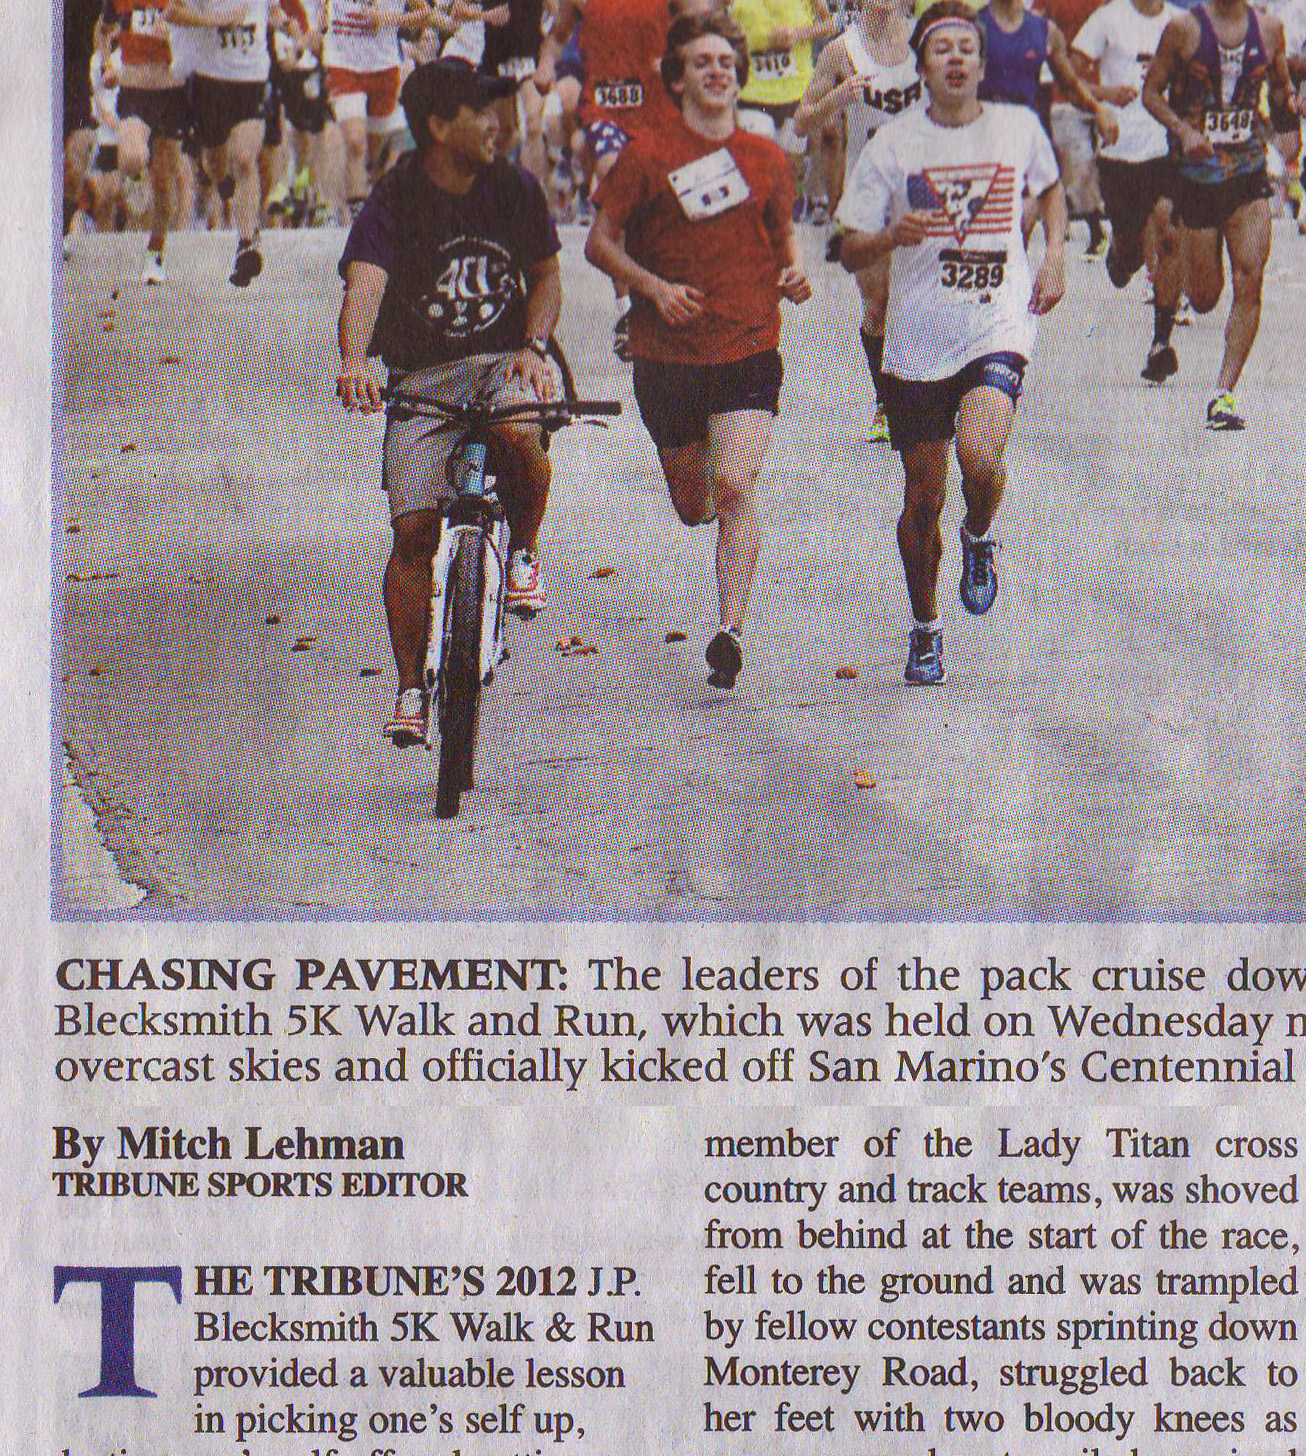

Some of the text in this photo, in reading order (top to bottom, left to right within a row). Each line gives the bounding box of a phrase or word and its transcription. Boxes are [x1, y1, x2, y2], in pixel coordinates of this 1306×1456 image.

[940, 262, 1005, 289] 3289
[55, 957, 277, 992] CHASING
[294, 957, 568, 992] PAVEMENT:
[587, 955, 662, 992] The
[681, 955, 820, 992] leaders
[840, 956, 879, 992] of
[897, 956, 961, 992] the
[979, 955, 1072, 1001] pack
[1091, 957, 1206, 992] cruise
[51, 1125, 405, 1170] By Mitch Lehman
[704, 1126, 1299, 1167] member of the Lady Titan cross
[51, 1171, 469, 1198] TRIBUNE SPORTS EDITOR
[194, 1264, 641, 1297] HE TRIBUNE’S 2012 J.P.
